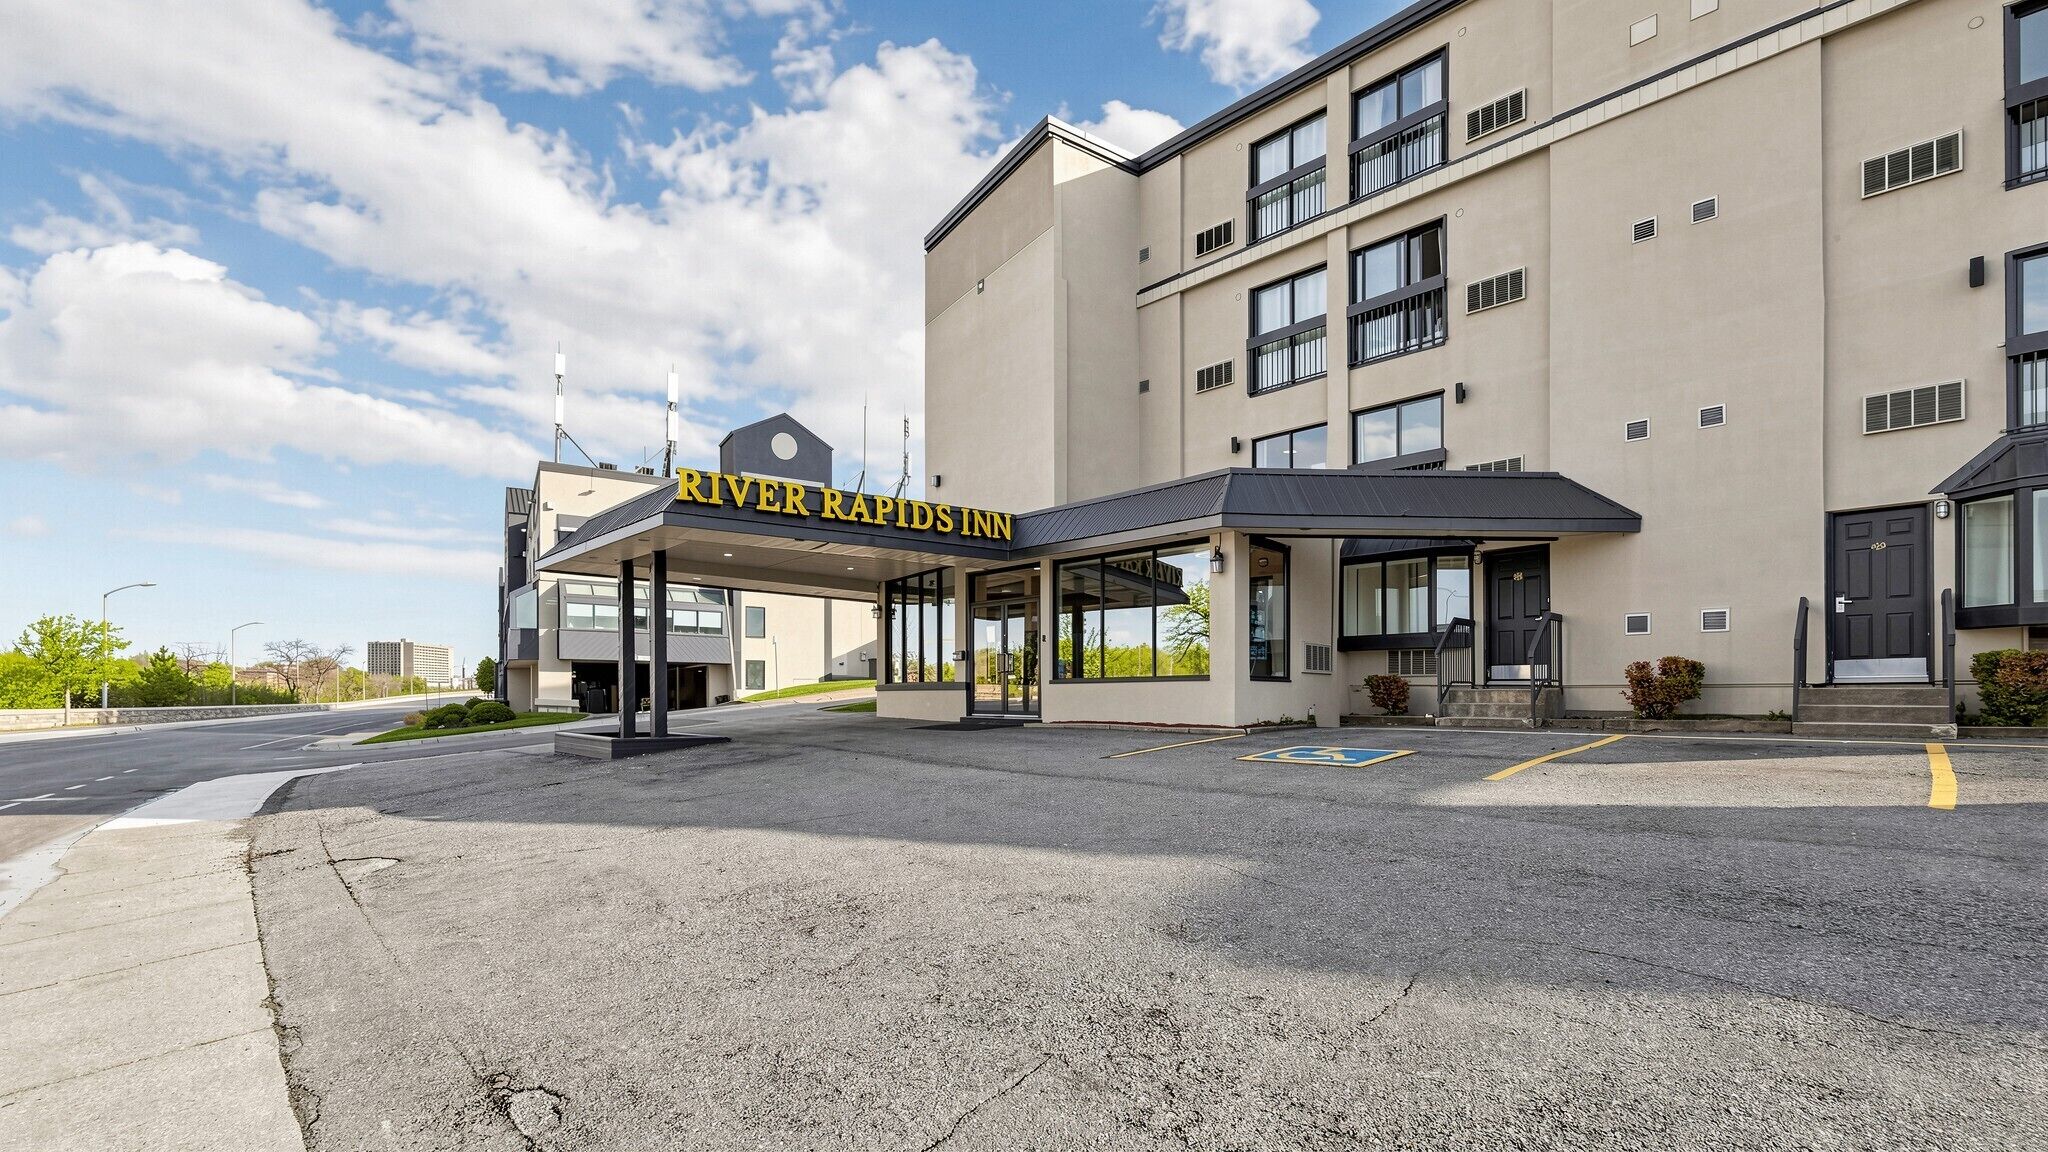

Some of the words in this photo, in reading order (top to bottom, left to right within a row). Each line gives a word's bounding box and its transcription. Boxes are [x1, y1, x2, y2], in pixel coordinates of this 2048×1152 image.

[677, 467, 810, 516] RIVER
[821, 487, 954, 533] RAPIDS
[961, 507, 1013, 541] INN
